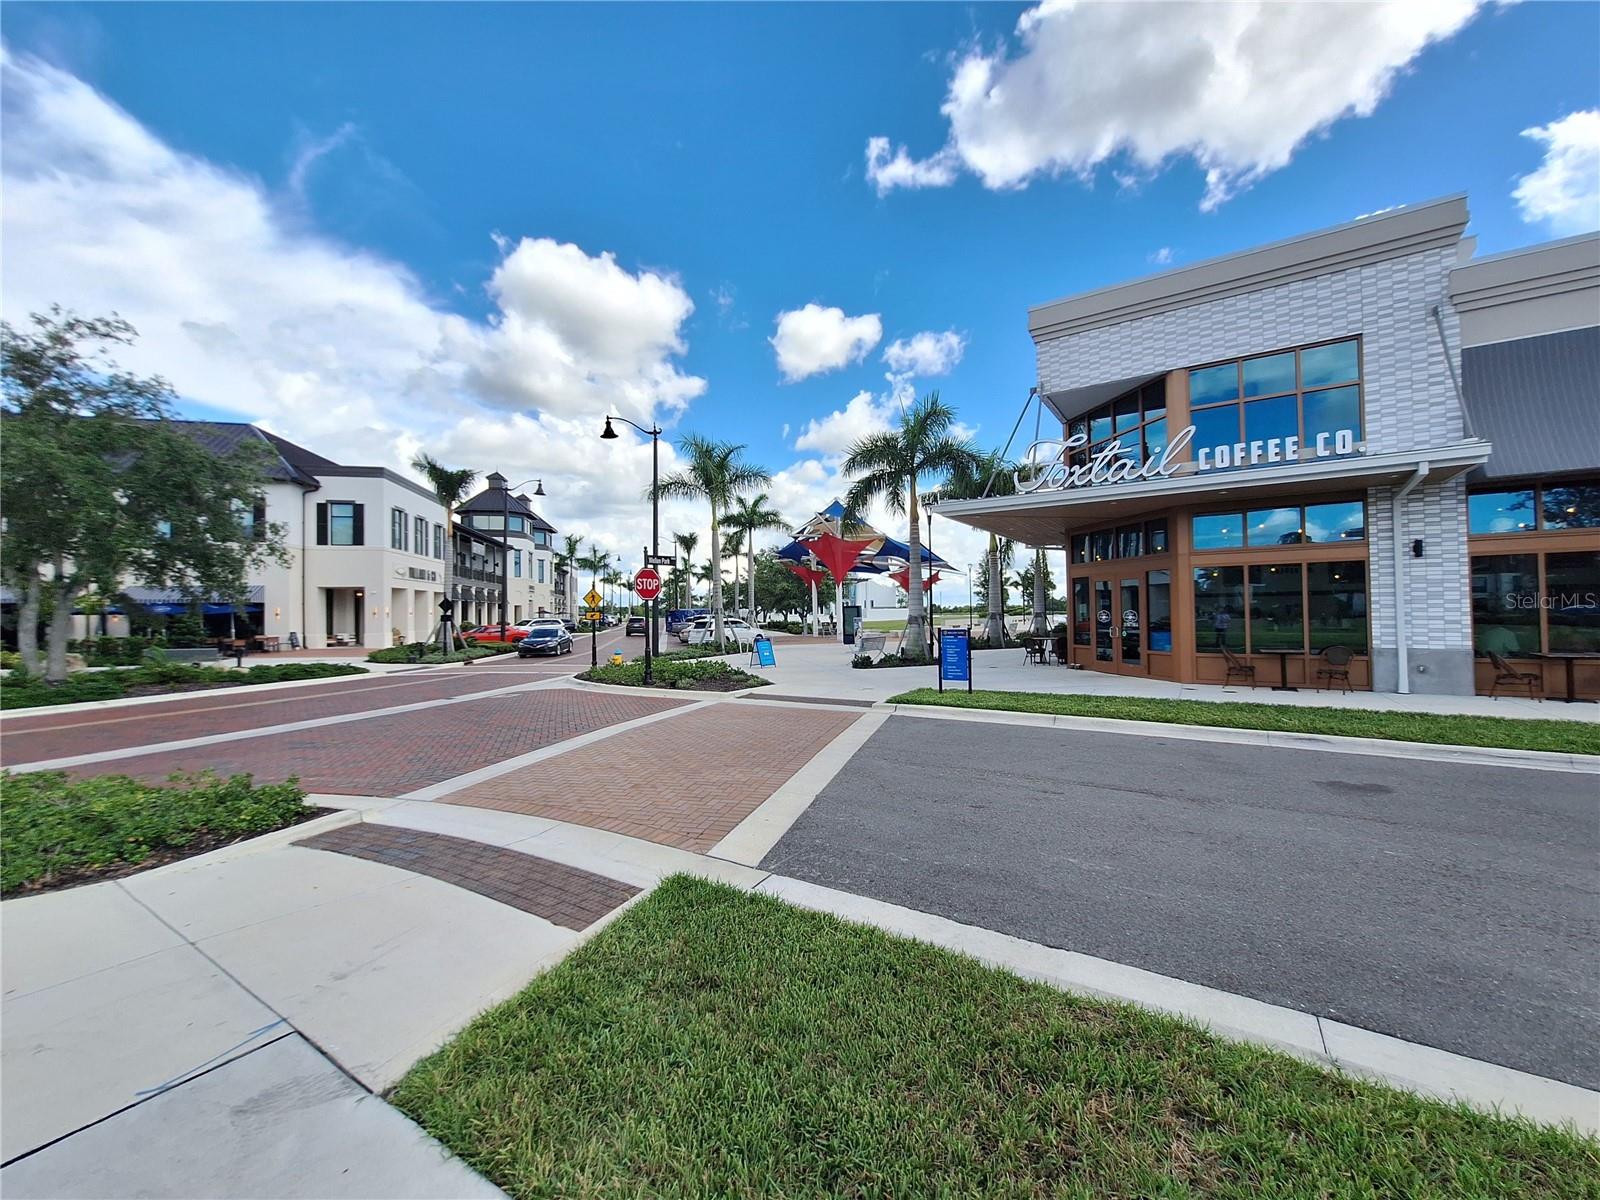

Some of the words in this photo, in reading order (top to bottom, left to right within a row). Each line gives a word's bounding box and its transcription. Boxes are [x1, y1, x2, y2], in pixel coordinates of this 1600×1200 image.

[1013, 425, 1197, 492] Foxtail
[1198, 435, 1299, 471] COFFEE
[1316, 429, 1367, 457] CO.
[636, 578, 659, 590] STOP
